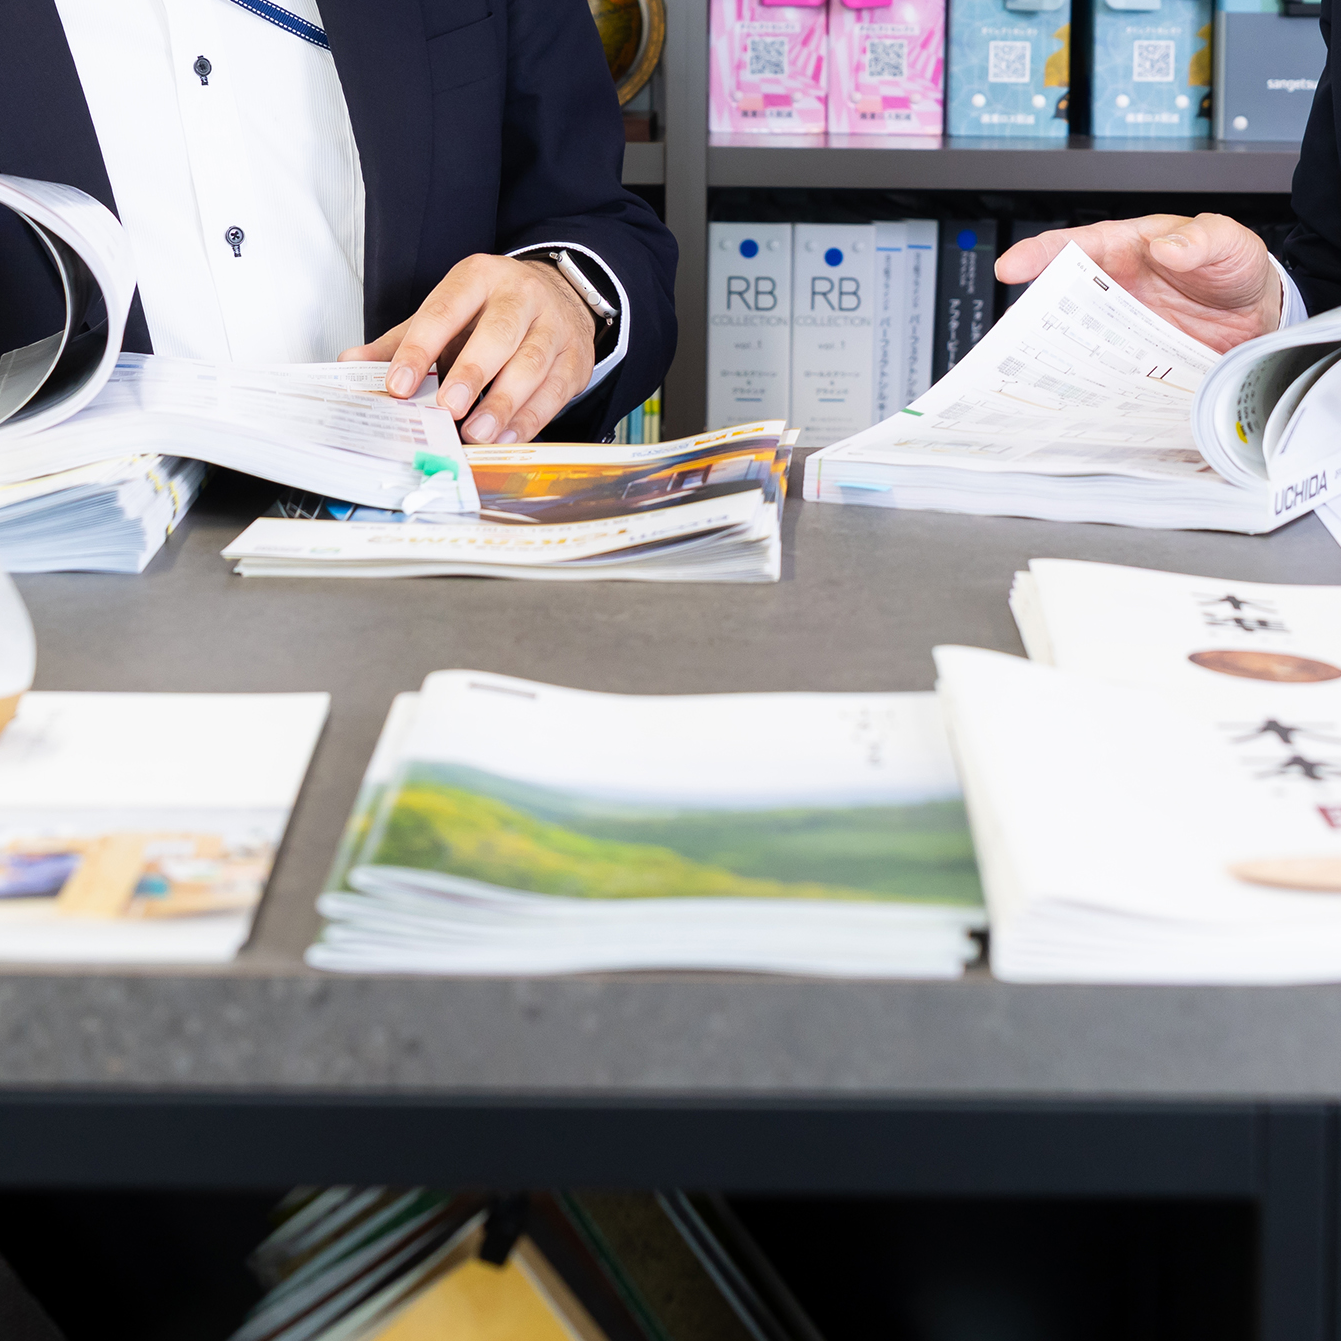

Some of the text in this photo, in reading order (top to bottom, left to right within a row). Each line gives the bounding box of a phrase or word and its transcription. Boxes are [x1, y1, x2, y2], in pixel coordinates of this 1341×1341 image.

[726, 276, 778, 311] RB
[810, 276, 862, 310] RB
[711, 314, 788, 328] COLLECTION
[795, 314, 871, 328] COLLECTION
[1274, 469, 1328, 516] UCHIDA
